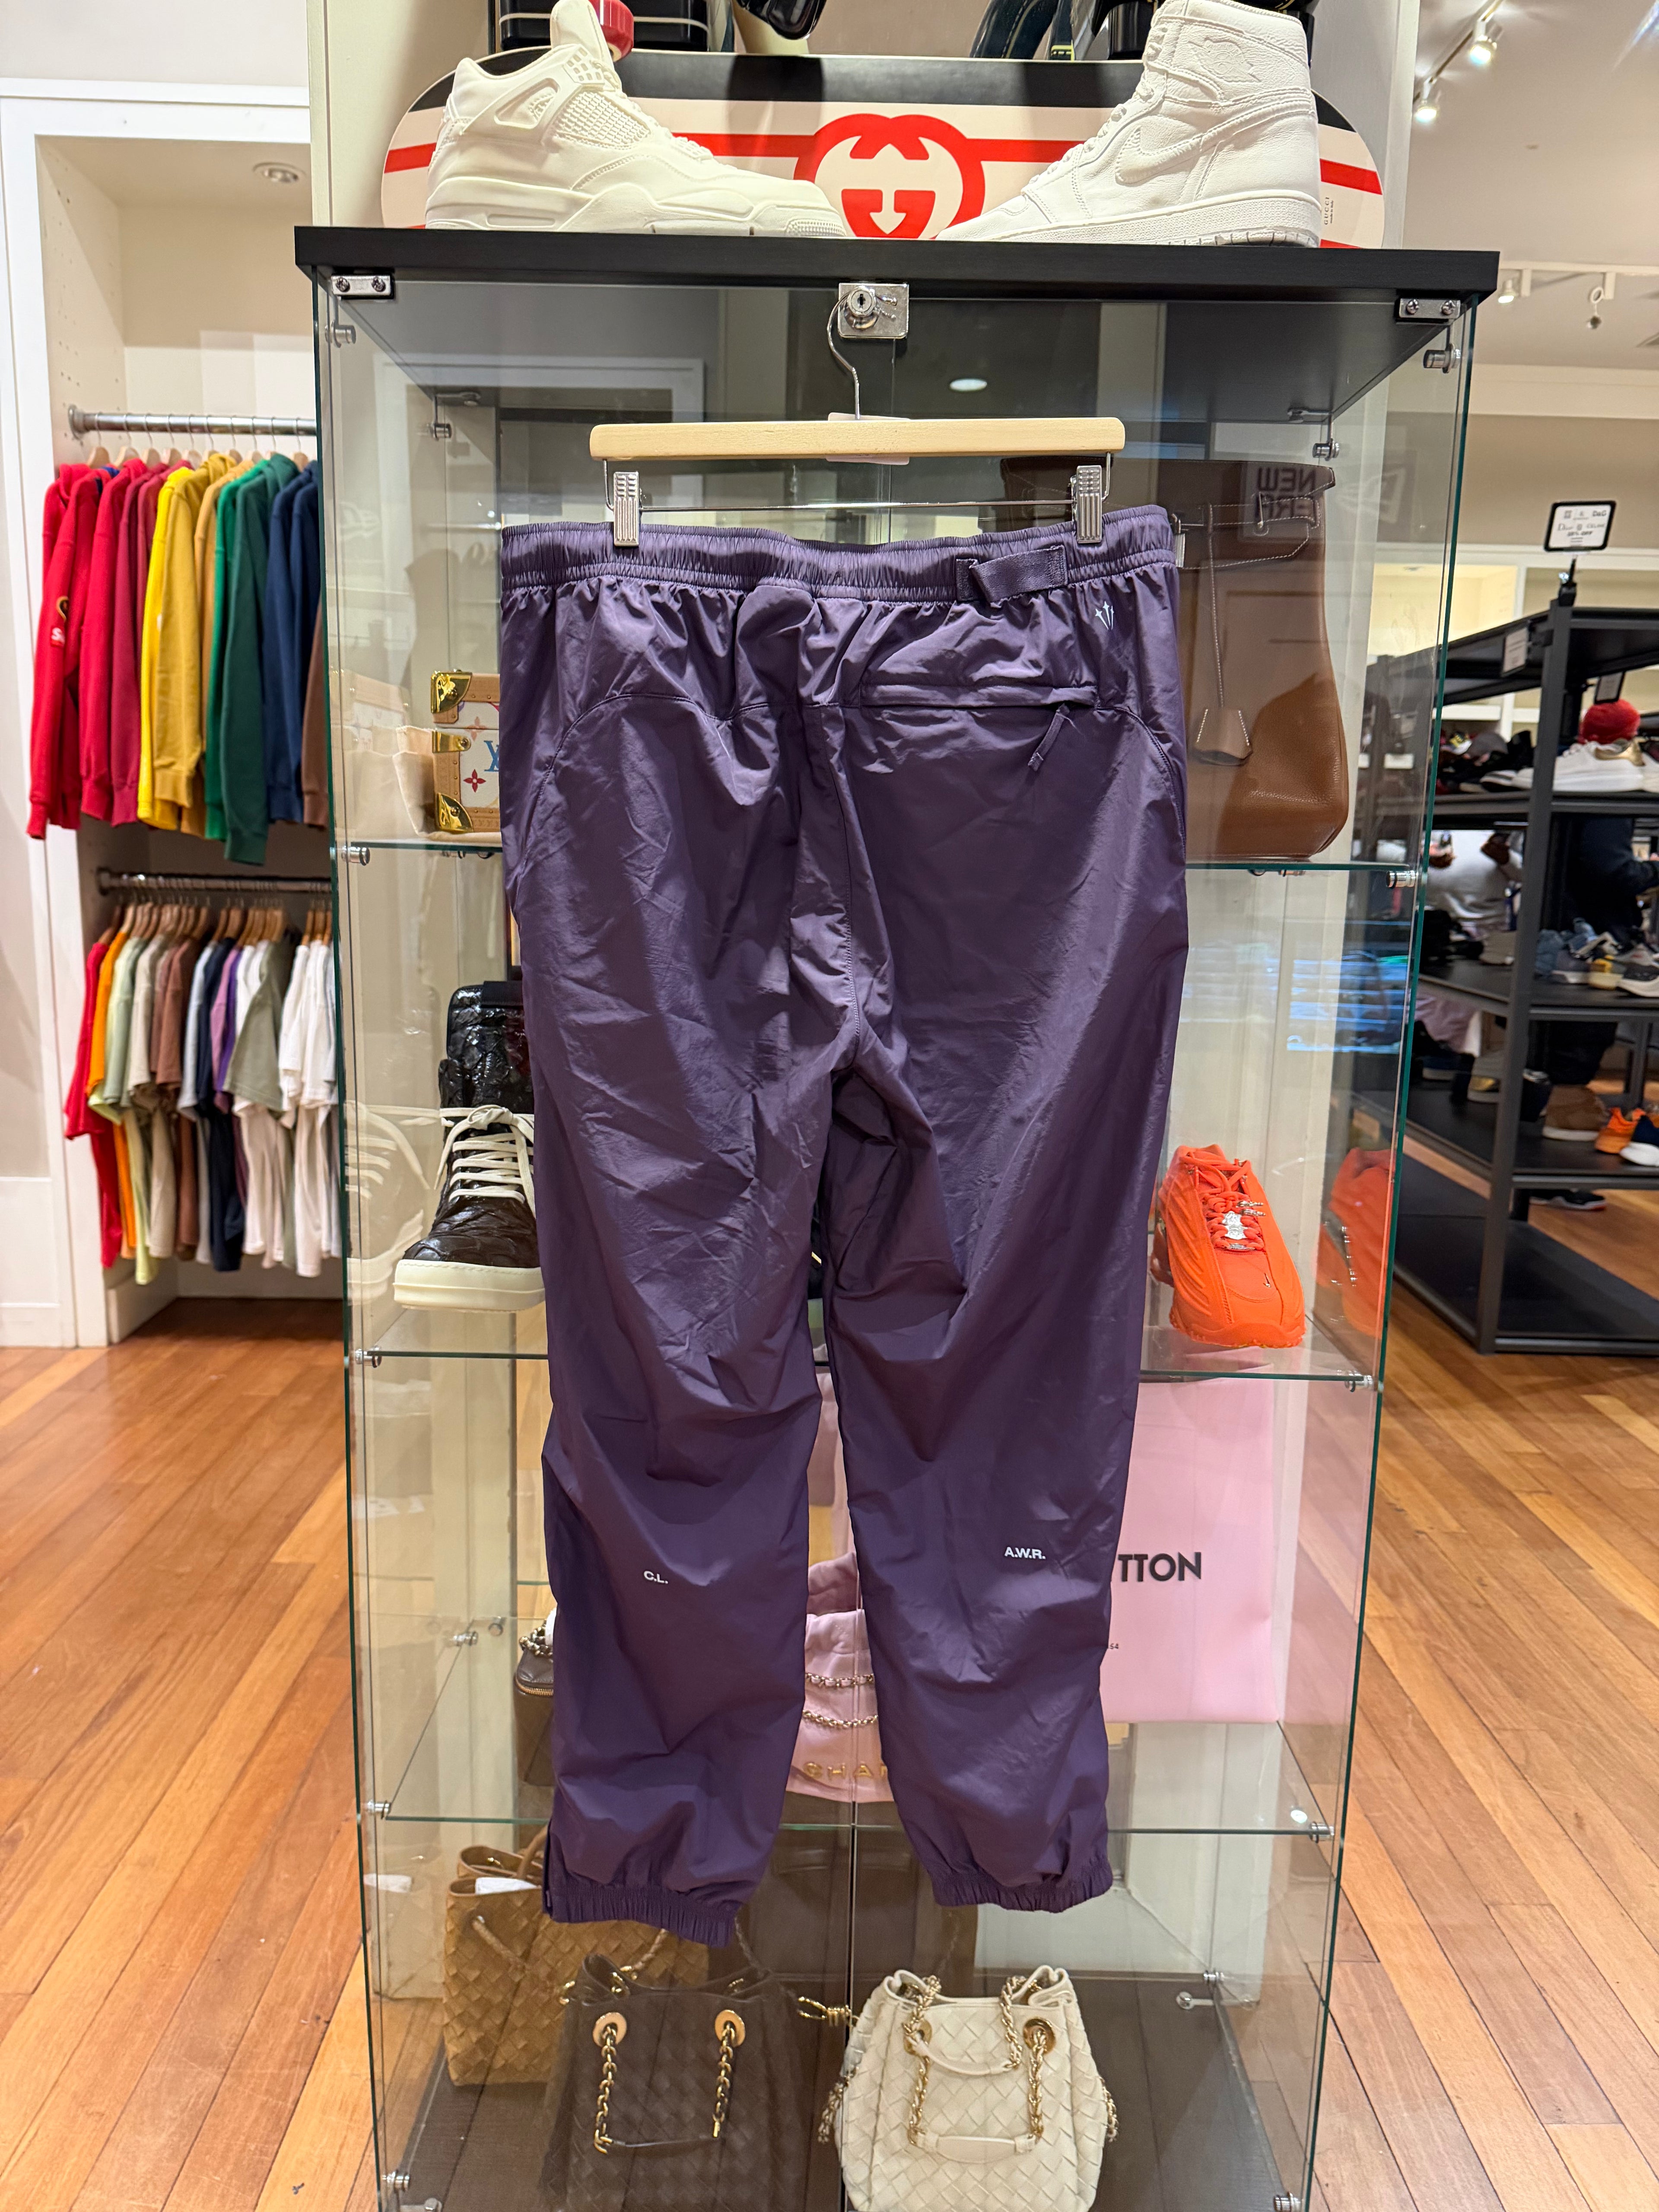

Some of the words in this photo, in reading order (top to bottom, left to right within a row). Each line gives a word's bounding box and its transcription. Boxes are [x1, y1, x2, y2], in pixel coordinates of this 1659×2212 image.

[1004, 1546, 1046, 1560] A.W.R.
[1118, 1551, 1202, 1583] TTON
[643, 1570, 668, 1584] C.L.
